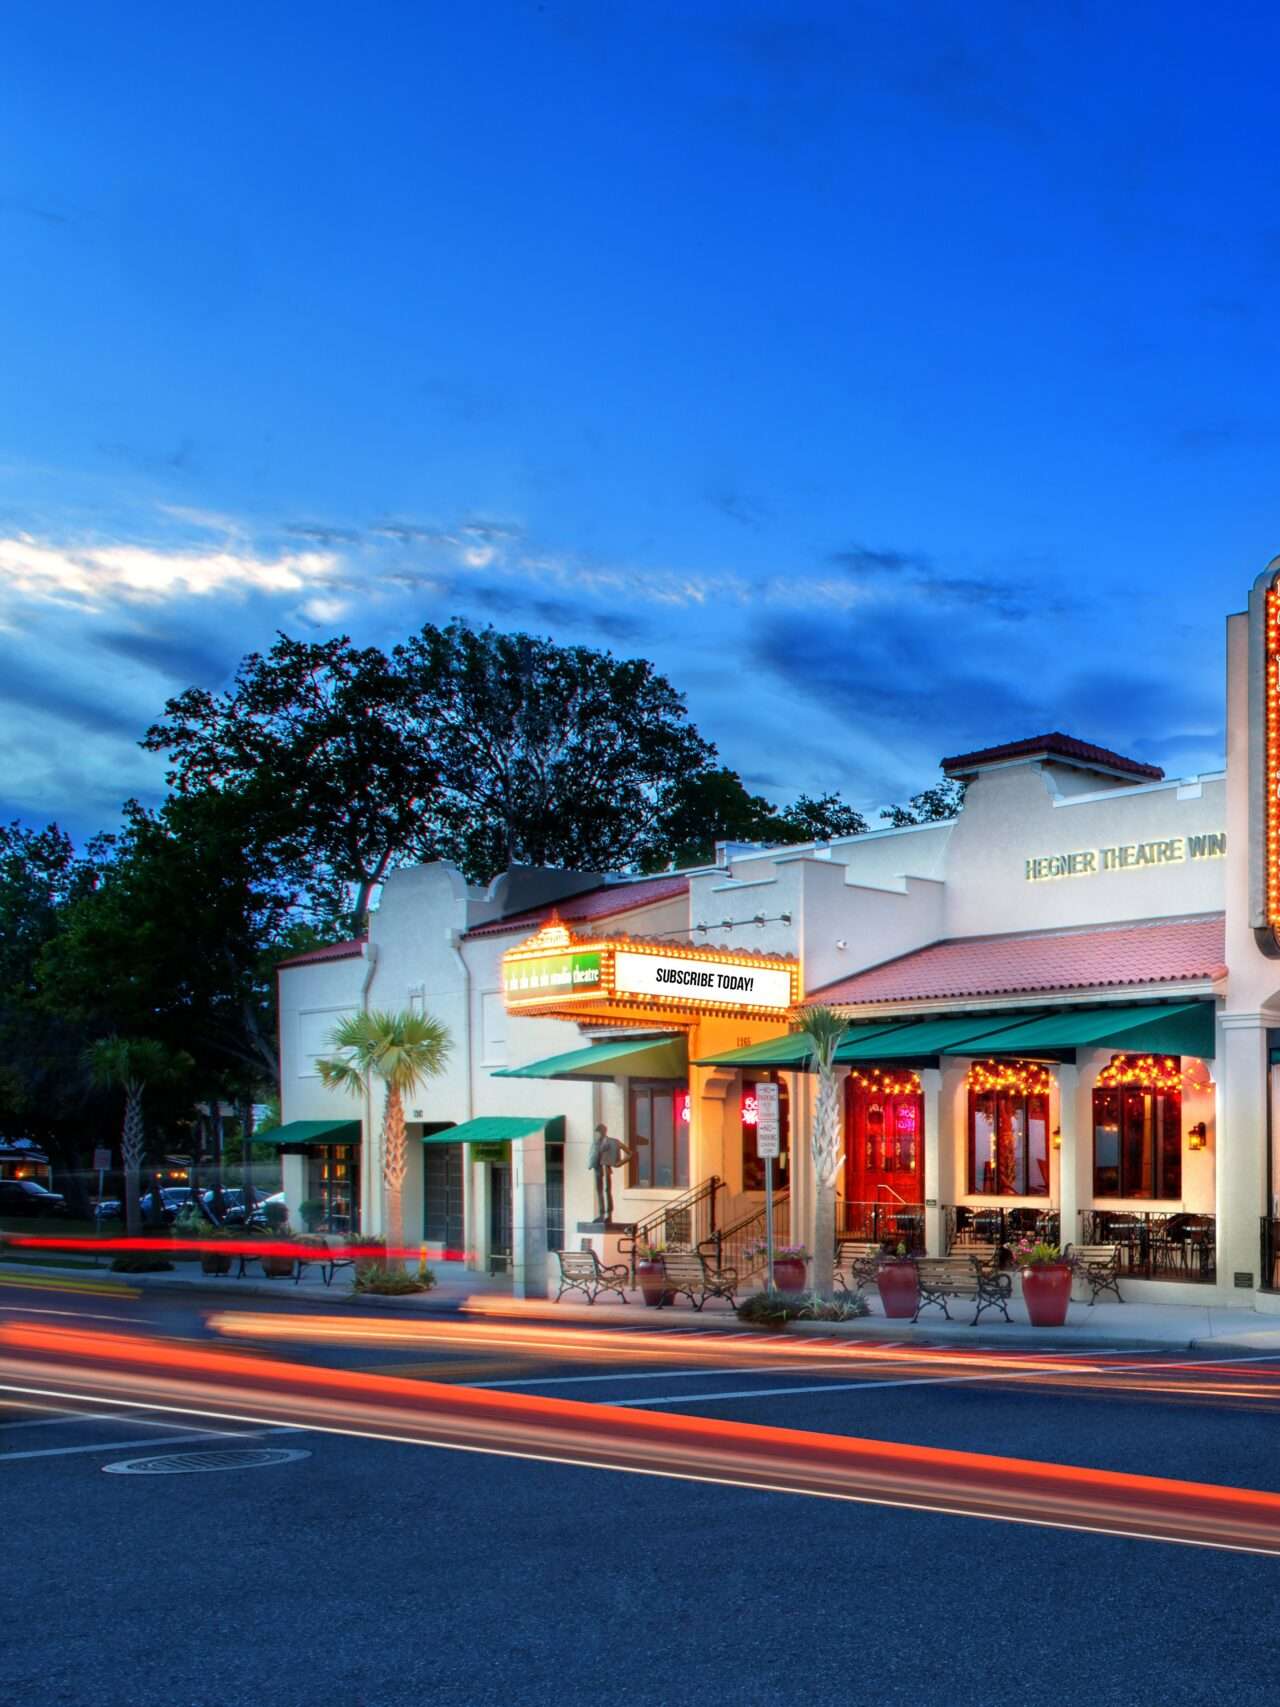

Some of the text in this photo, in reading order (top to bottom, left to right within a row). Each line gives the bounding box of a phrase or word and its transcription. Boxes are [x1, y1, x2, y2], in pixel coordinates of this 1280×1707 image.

[1025, 851, 1096, 880] HEGNER
[1100, 839, 1183, 870] THEATRE
[656, 968, 754, 992] SUBSCRIBE TODAY!
